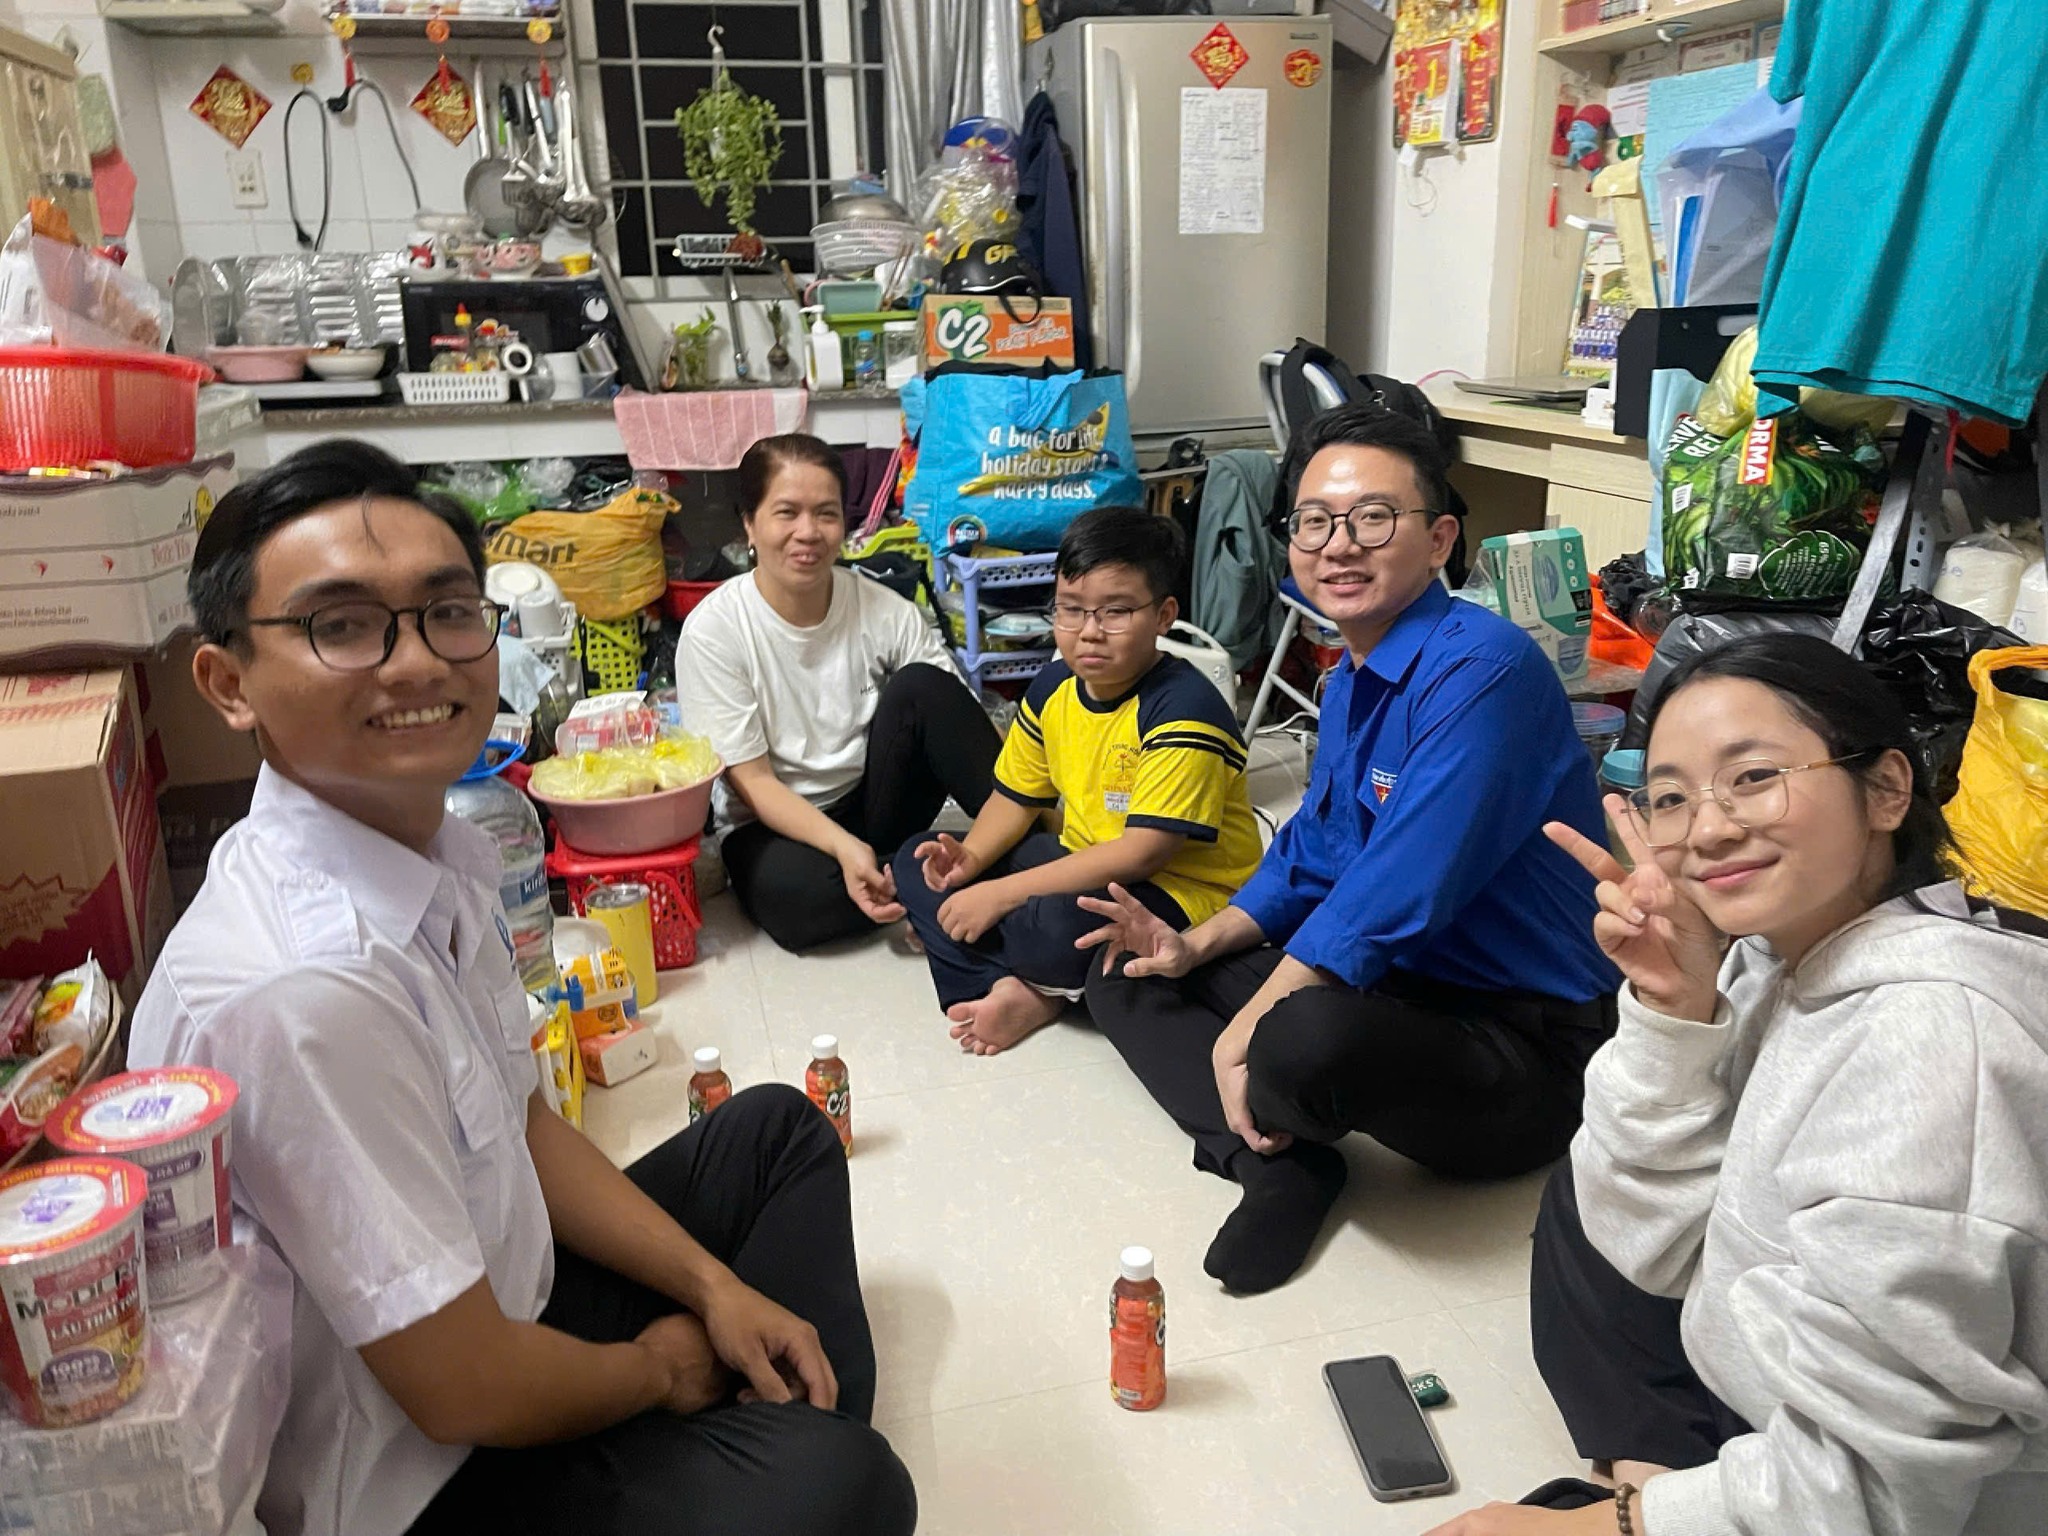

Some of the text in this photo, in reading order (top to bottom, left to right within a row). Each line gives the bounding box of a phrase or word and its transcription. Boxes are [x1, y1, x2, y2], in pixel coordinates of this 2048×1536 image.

[937, 307, 991, 359] C2
[988, 426, 1002, 447] a
[1049, 428, 1077, 450] for
[981, 451, 1050, 477] holiday
[486, 530, 580, 564] mart
[826, 1091, 850, 1117] C2
